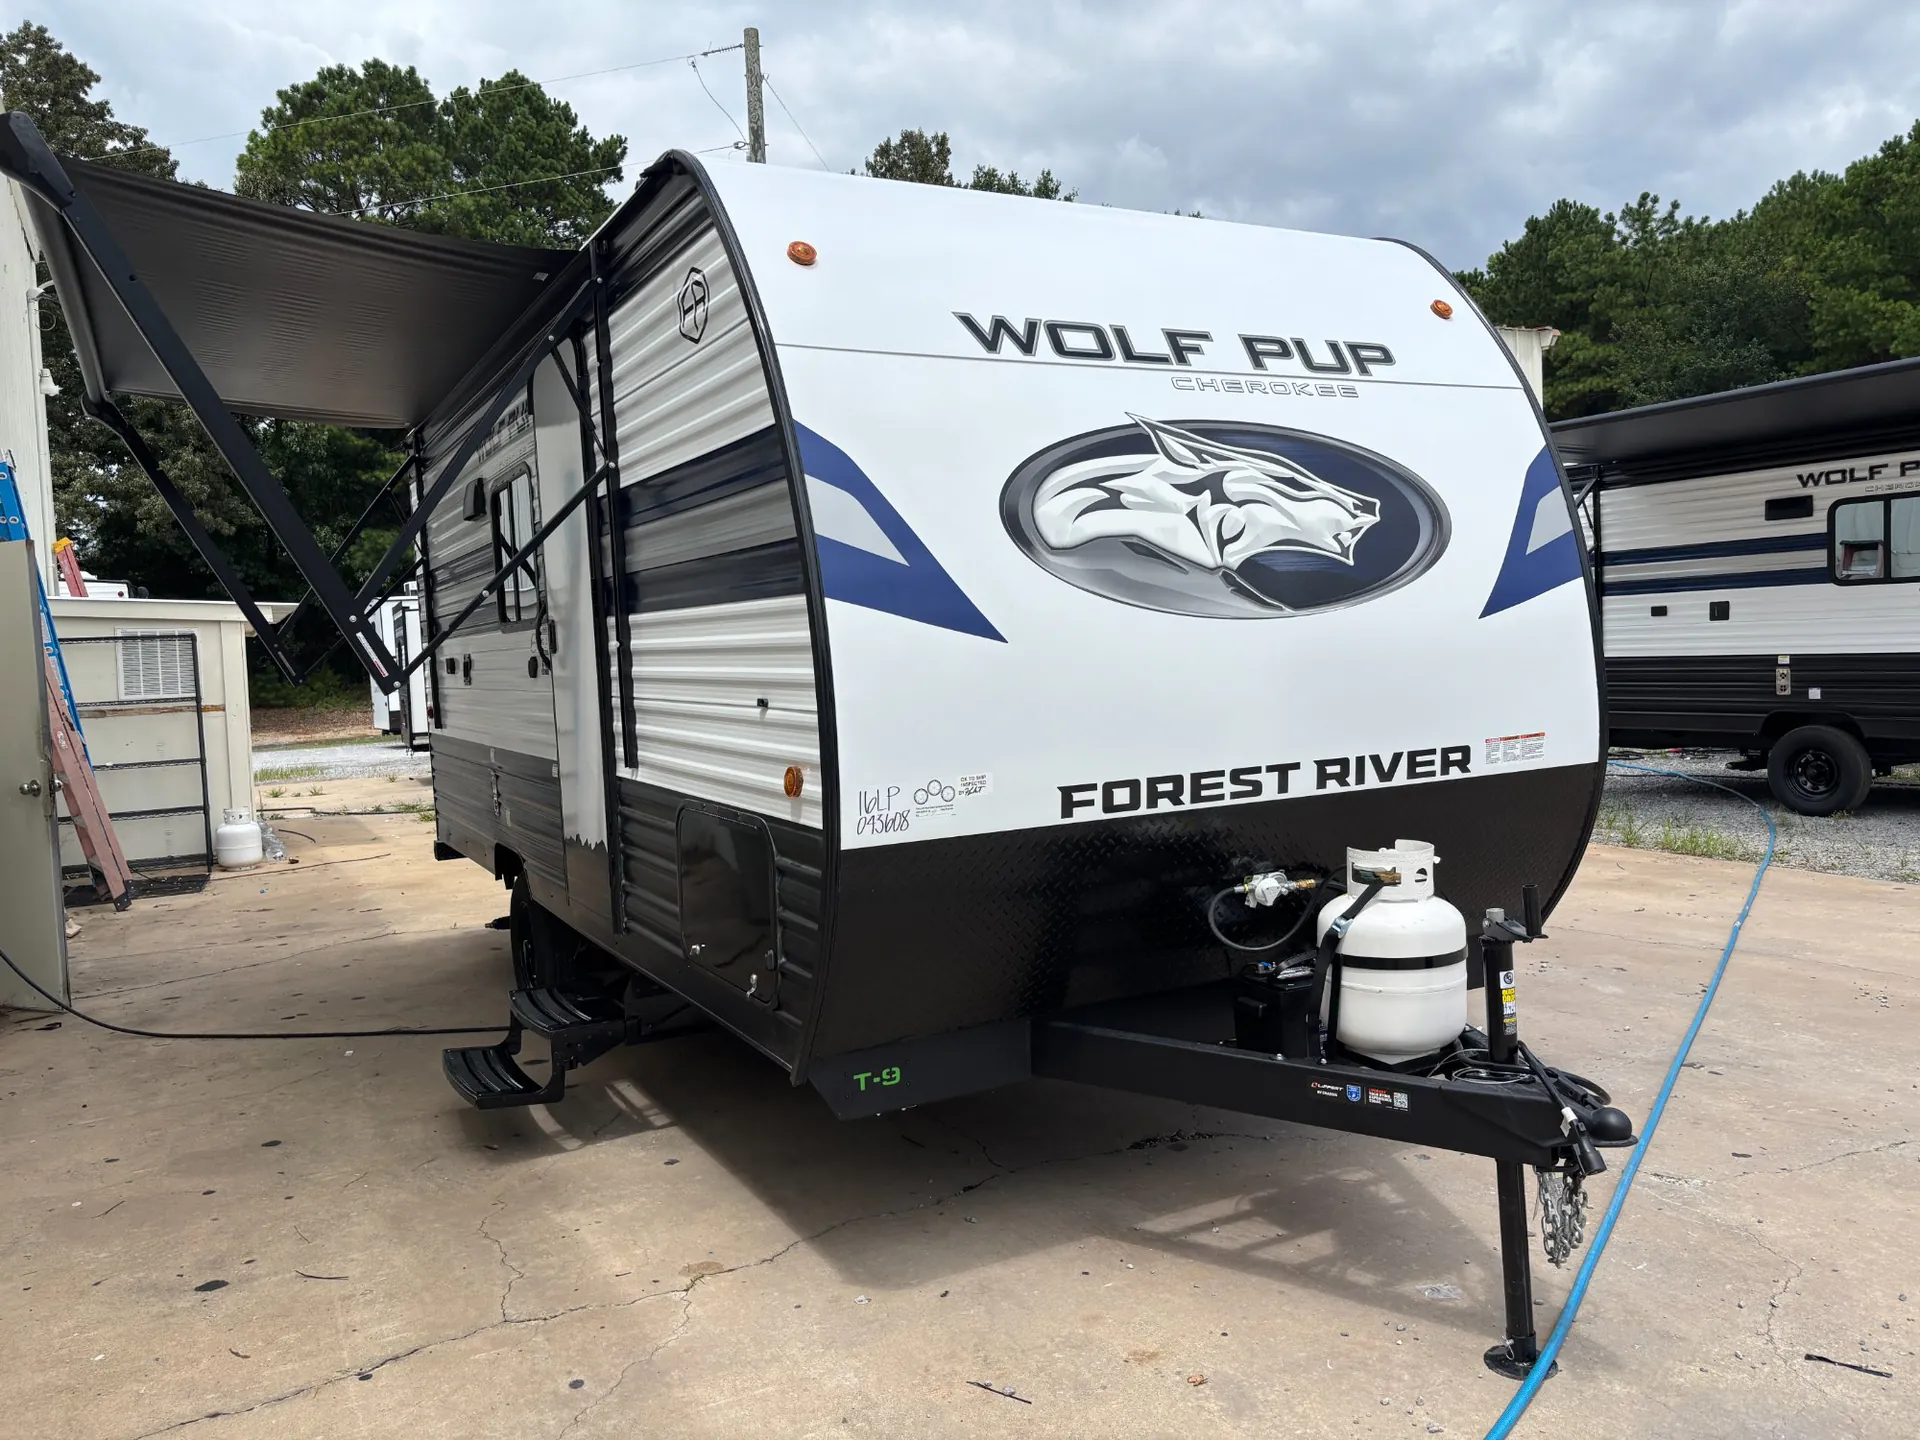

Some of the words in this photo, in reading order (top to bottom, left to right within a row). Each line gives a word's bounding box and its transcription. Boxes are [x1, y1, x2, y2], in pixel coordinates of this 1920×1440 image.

[951, 311, 1214, 367] WOLF
[1238, 333, 1396, 377] PUP
[1170, 376, 1360, 398] CHEROKEE
[1796, 463, 1889, 488] WOLF
[1056, 761, 1301, 820] FOREST
[1312, 744, 1472, 790] RIVER
[858, 785, 901, 816] 16LP
[853, 1066, 901, 1092] T-9
